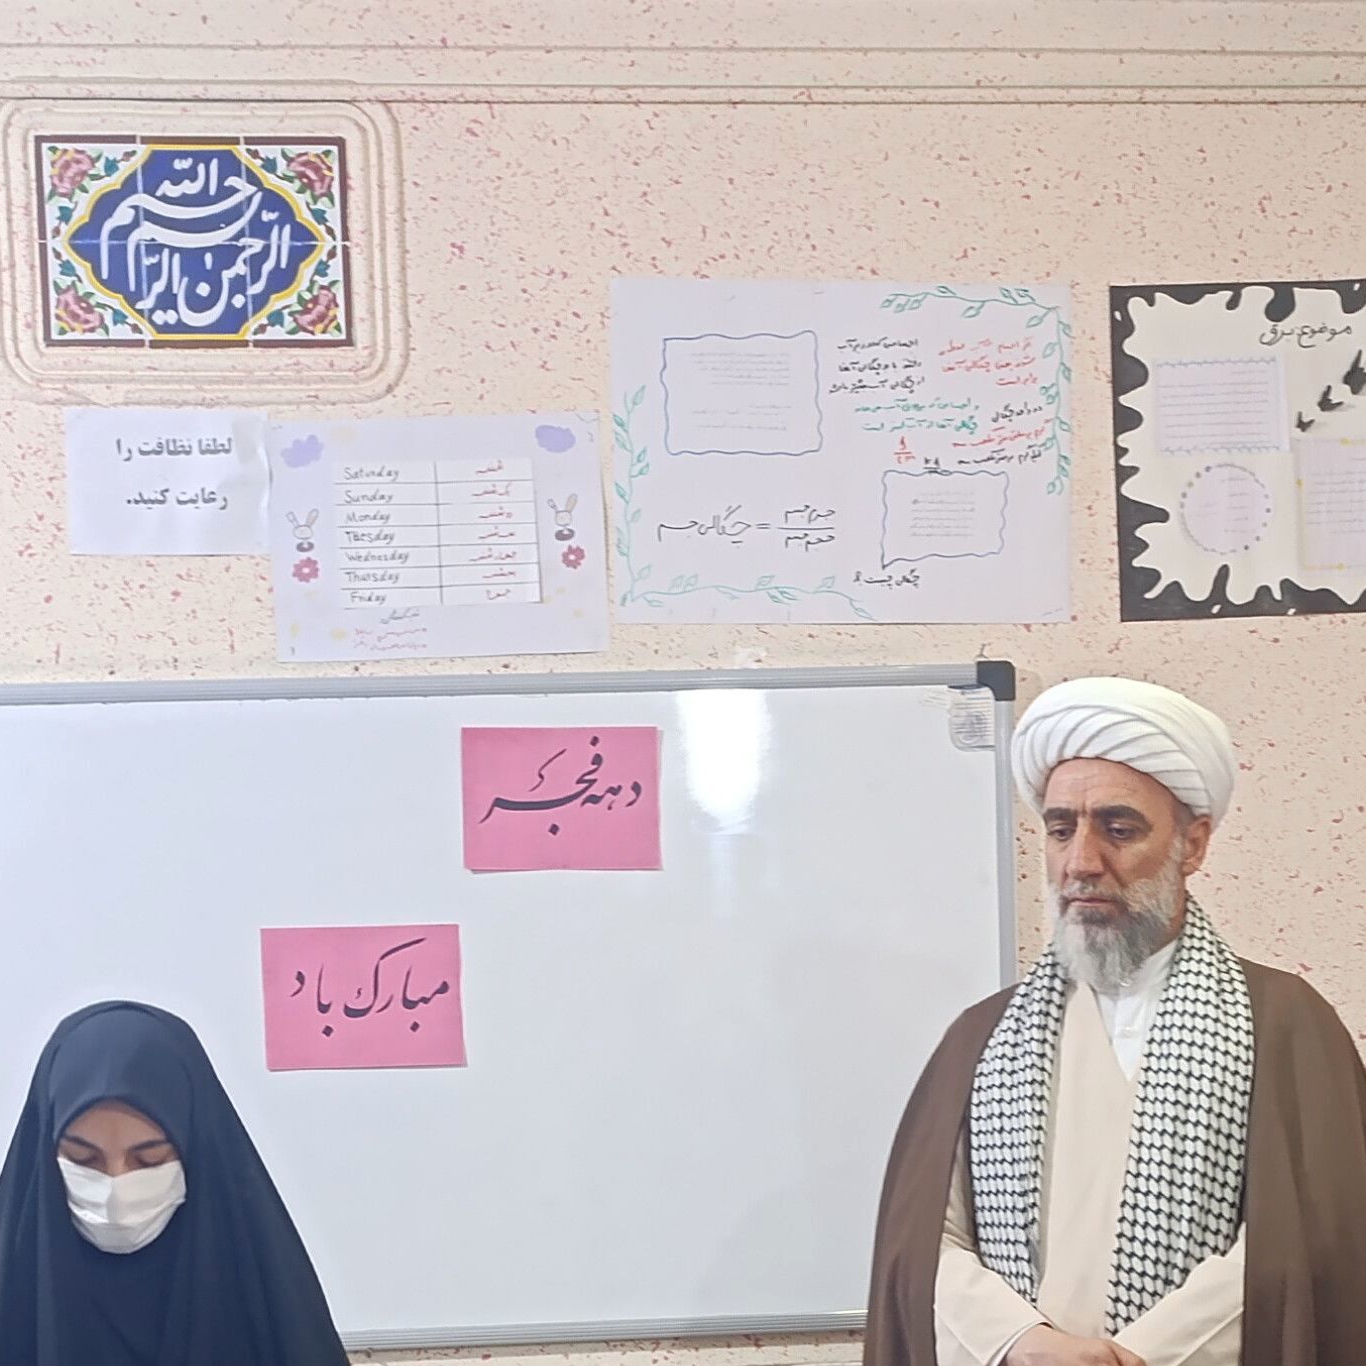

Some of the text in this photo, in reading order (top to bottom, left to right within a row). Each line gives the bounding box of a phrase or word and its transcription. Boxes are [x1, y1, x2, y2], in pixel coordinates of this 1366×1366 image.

[156, 157, 218, 199] الله
[116, 437, 232, 462] لطفا نظافت را
[344, 465, 399, 481] Saturday
[126, 487, 228, 510] رعایت کنید.
[344, 488, 394, 504] Sunday
[346, 510, 391, 525] Monday
[344, 550, 409, 564] Wednesday
[350, 591, 387, 605] Friday
[478, 735, 642, 836] دهه فجر
[290, 937, 450, 1037] مبارک باد
